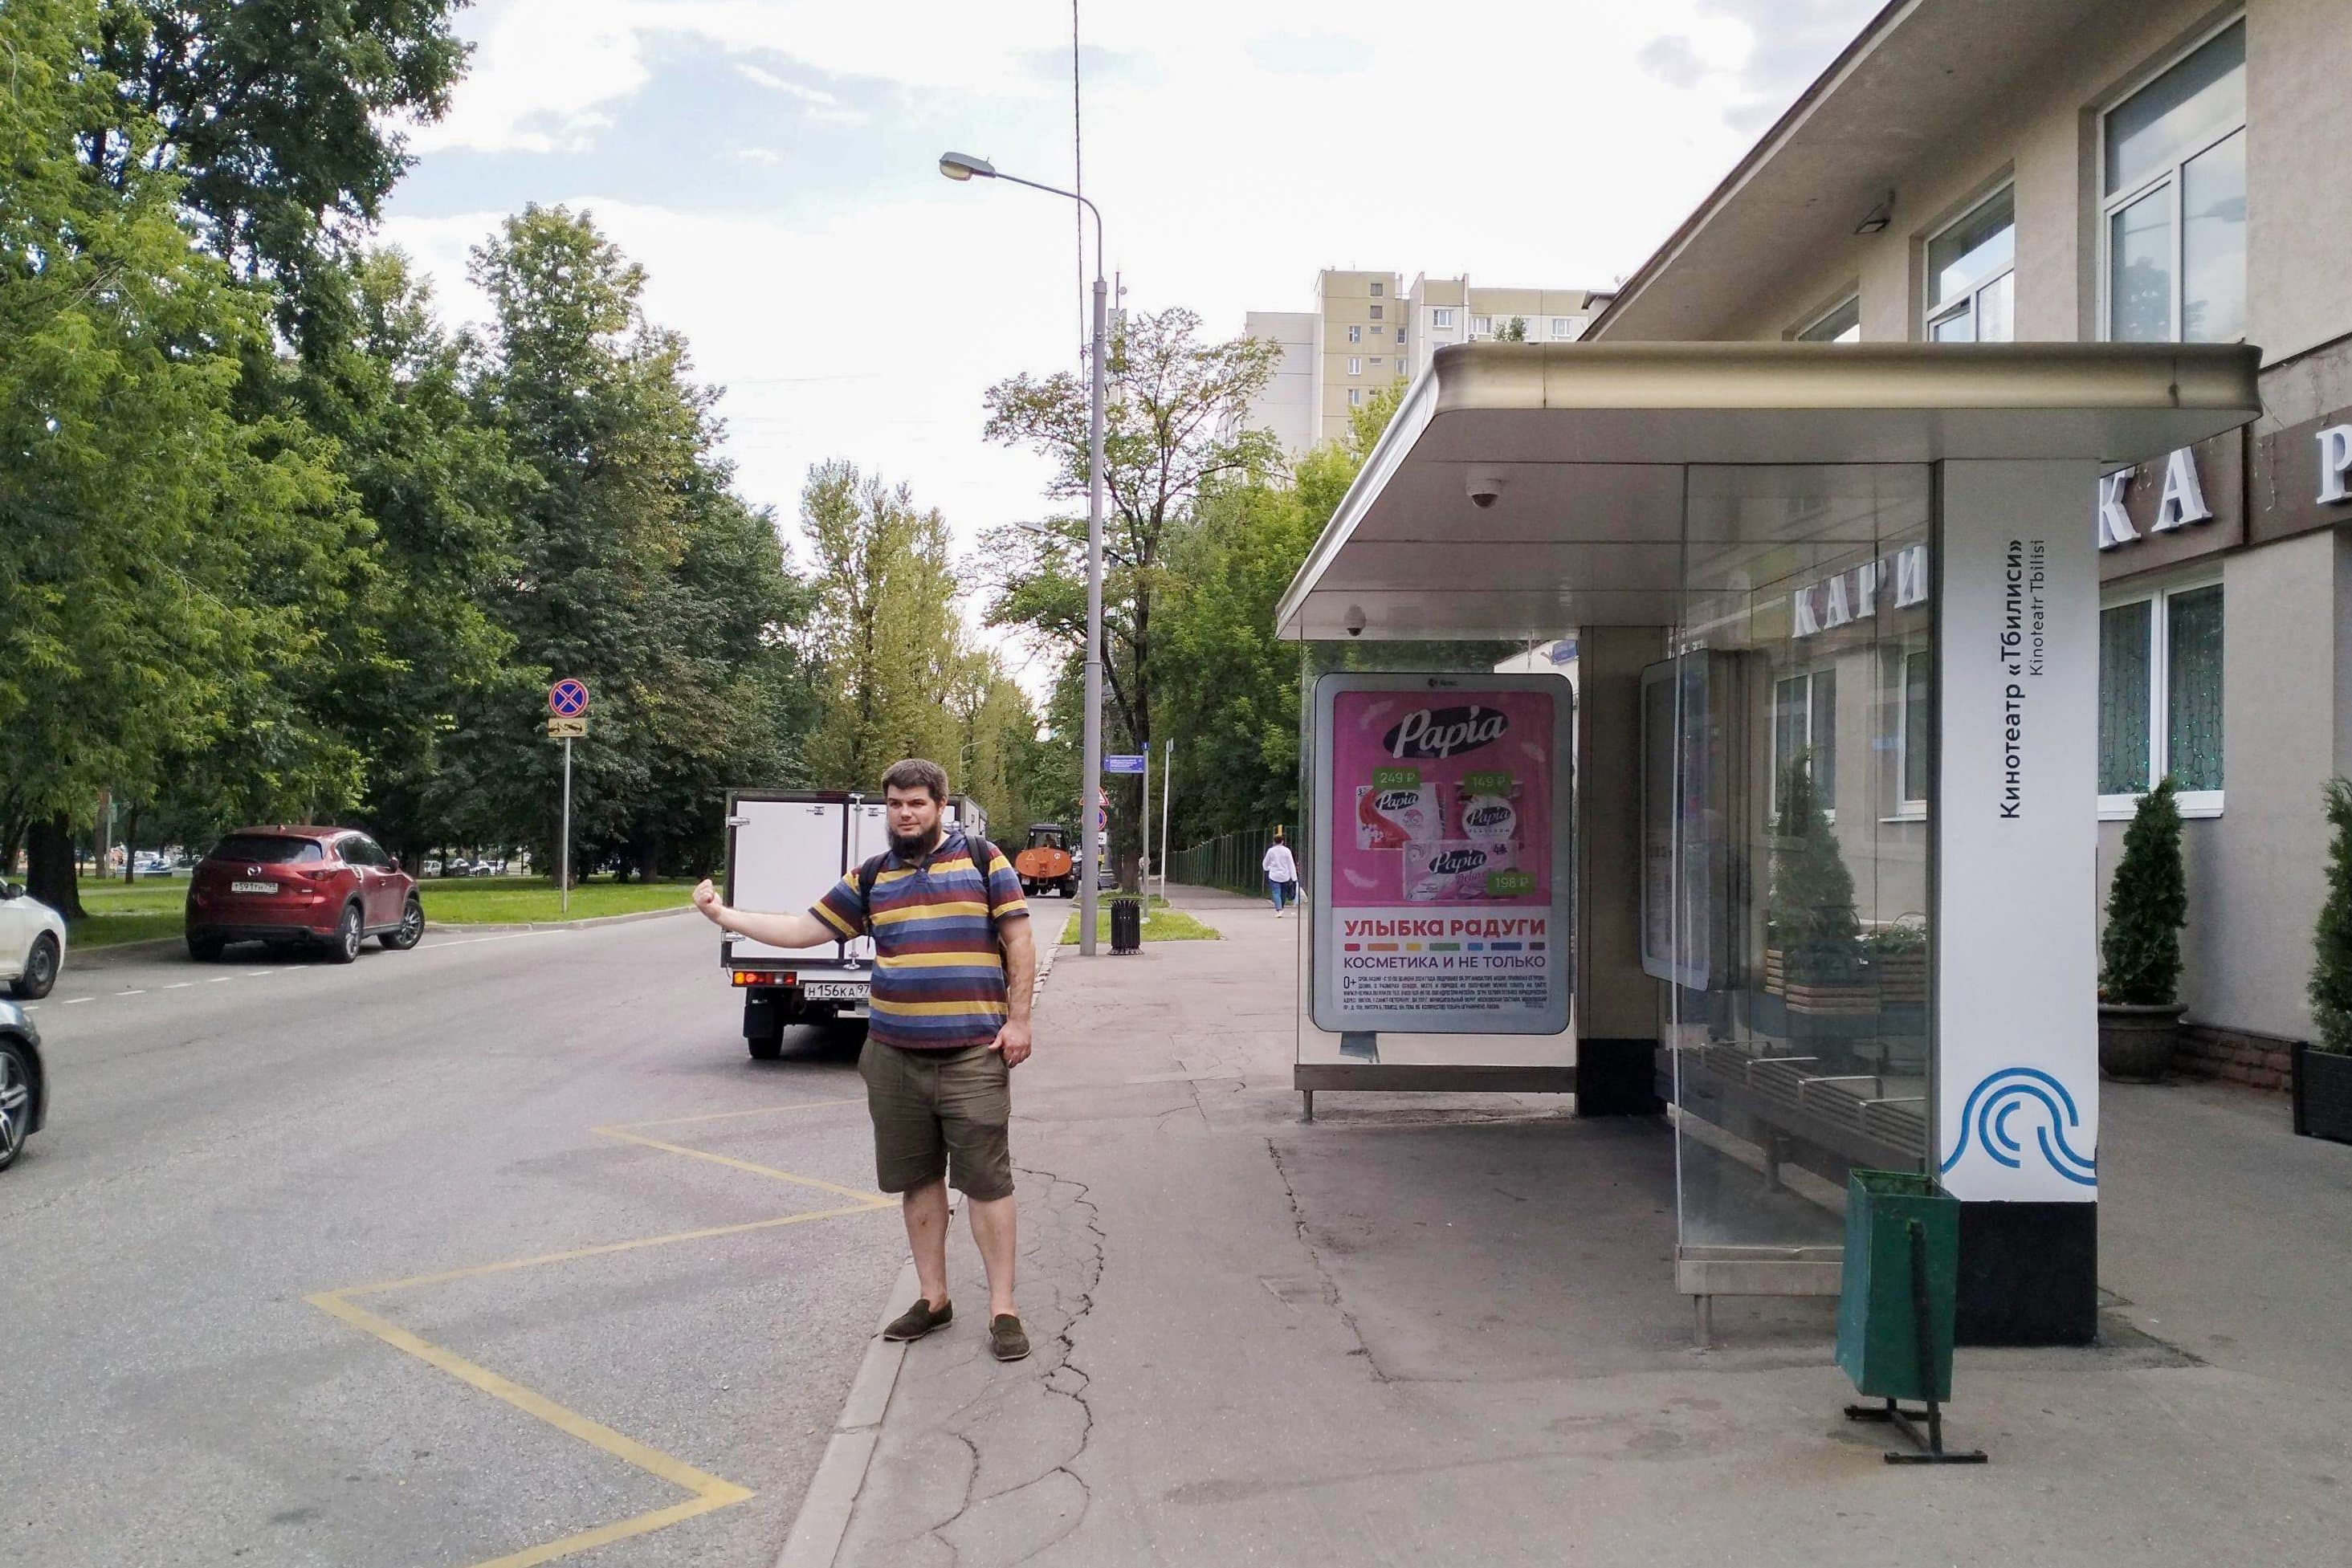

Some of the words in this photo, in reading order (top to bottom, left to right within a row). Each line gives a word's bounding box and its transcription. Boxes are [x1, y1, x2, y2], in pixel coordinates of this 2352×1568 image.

[2029, 540, 2044, 593] Tbilisi
[2000, 540, 2022, 676] «Тбилиси»
[2029, 597, 2044, 676] Kinoteatr
[1392, 705, 1507, 760] Papia
[2000, 684, 2025, 819] Кинотеатр
[1380, 772, 1403, 784] 249
[1473, 776, 1494, 787] 149
[1378, 792, 1418, 810] Papia
[1470, 806, 1509, 825] Papia
[1434, 849, 1484, 874] Papia
[1495, 877, 1517, 888] 198
[1344, 956, 1439, 969] КОСМЕТИКА
[1445, 956, 1454, 968] И
[1459, 956, 1478, 968] НЕ
[1482, 955, 1546, 968] ТОЛЬКО
[1343, 975, 1357, 989] 0+
